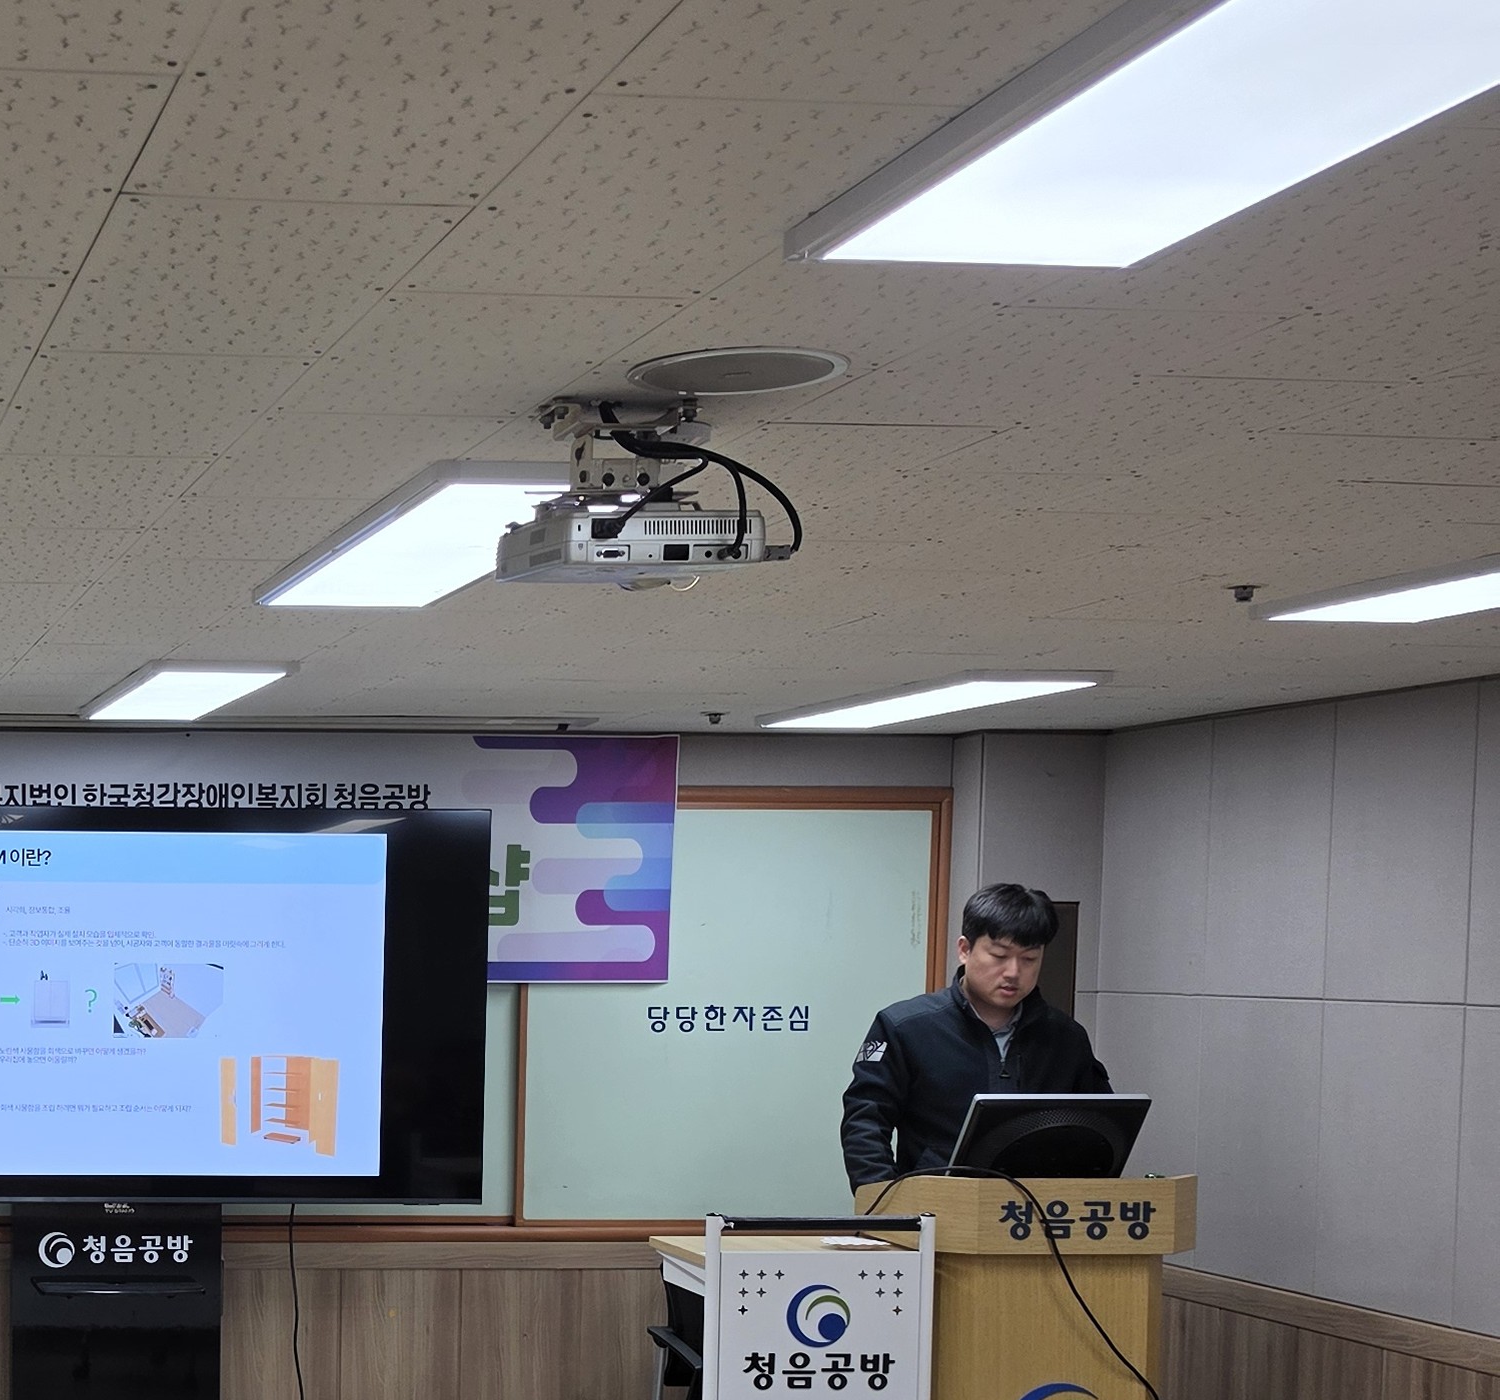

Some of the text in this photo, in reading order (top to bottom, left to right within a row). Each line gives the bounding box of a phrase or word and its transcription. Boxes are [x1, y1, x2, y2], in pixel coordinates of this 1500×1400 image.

[333, 783, 432, 810] 청음공방
[10, 848, 52, 867] 이란?
[999, 1200, 1157, 1241] 청음공방
[82, 1235, 194, 1264] 청음공방
[742, 1352, 896, 1391] 청음공방
